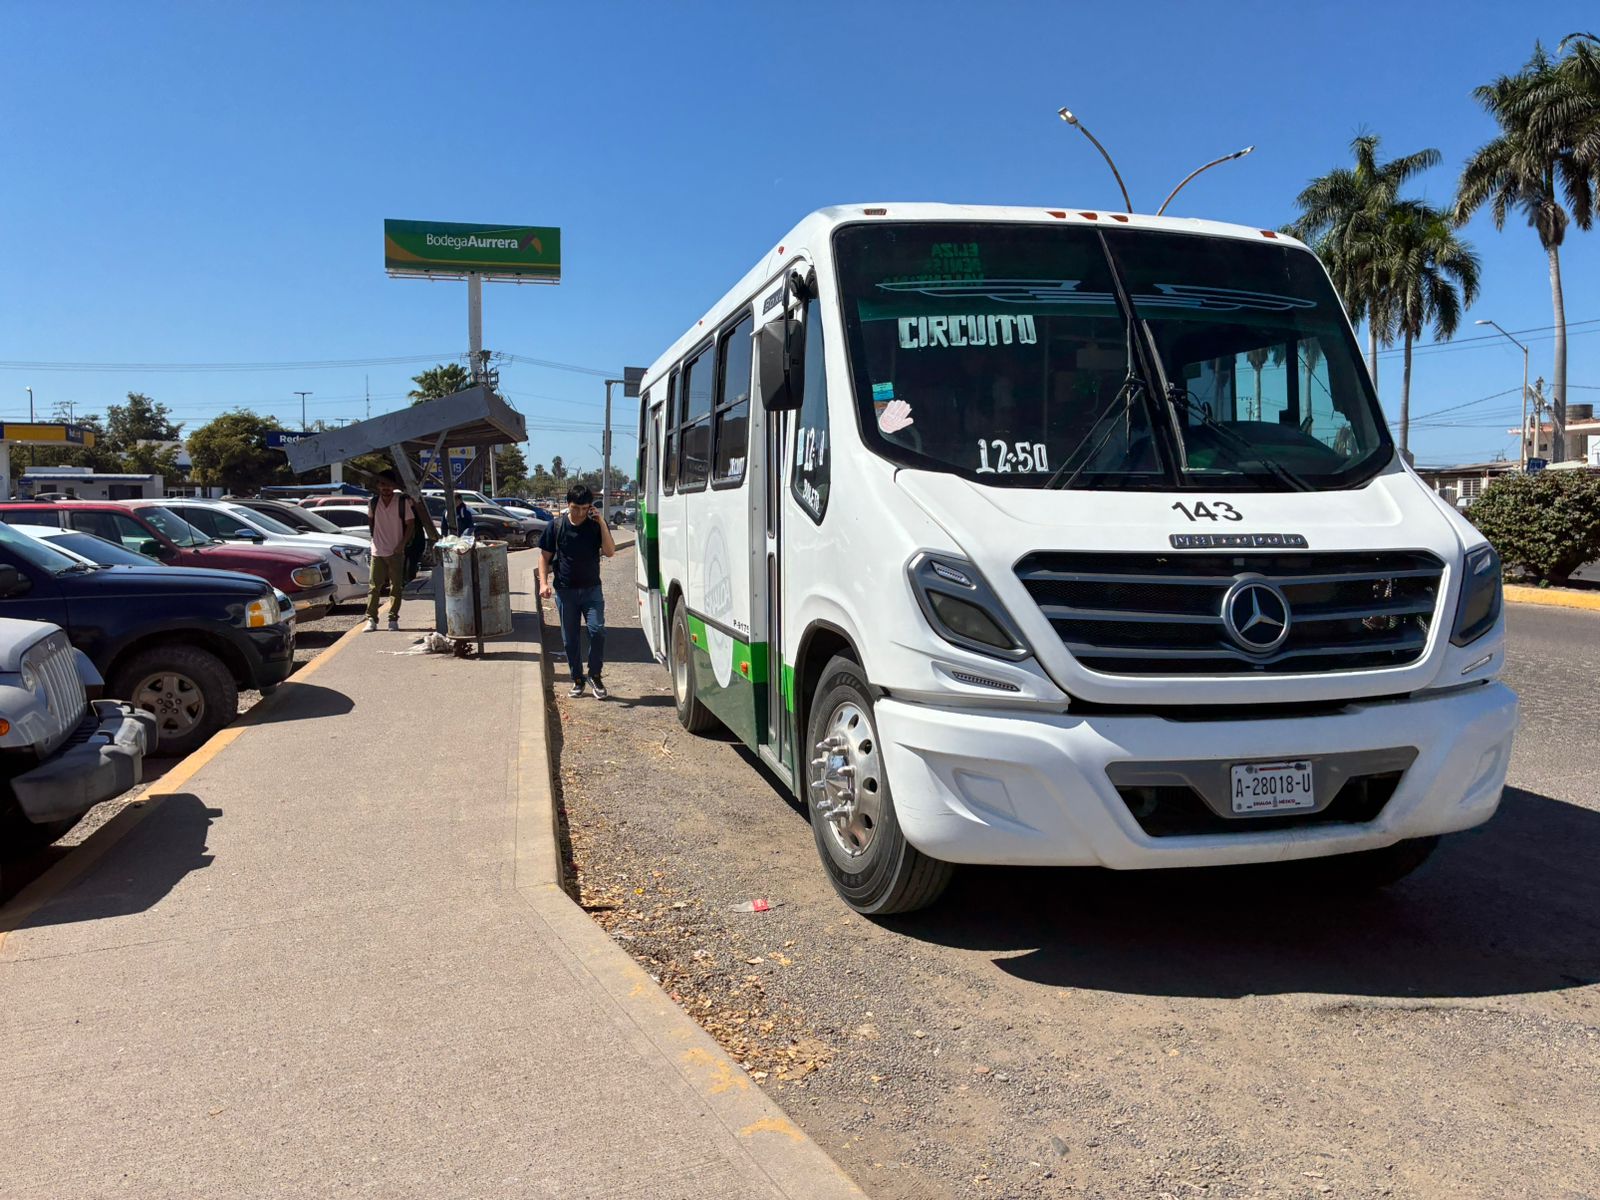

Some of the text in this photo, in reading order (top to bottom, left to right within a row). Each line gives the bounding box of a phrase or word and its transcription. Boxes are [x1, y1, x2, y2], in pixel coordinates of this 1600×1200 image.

[426, 233, 518, 250] BodegaAurrera
[898, 314, 1038, 349] CIRCUITO
[1171, 501, 1244, 522] 143
[1236, 774, 1311, 797] A-28018-U
